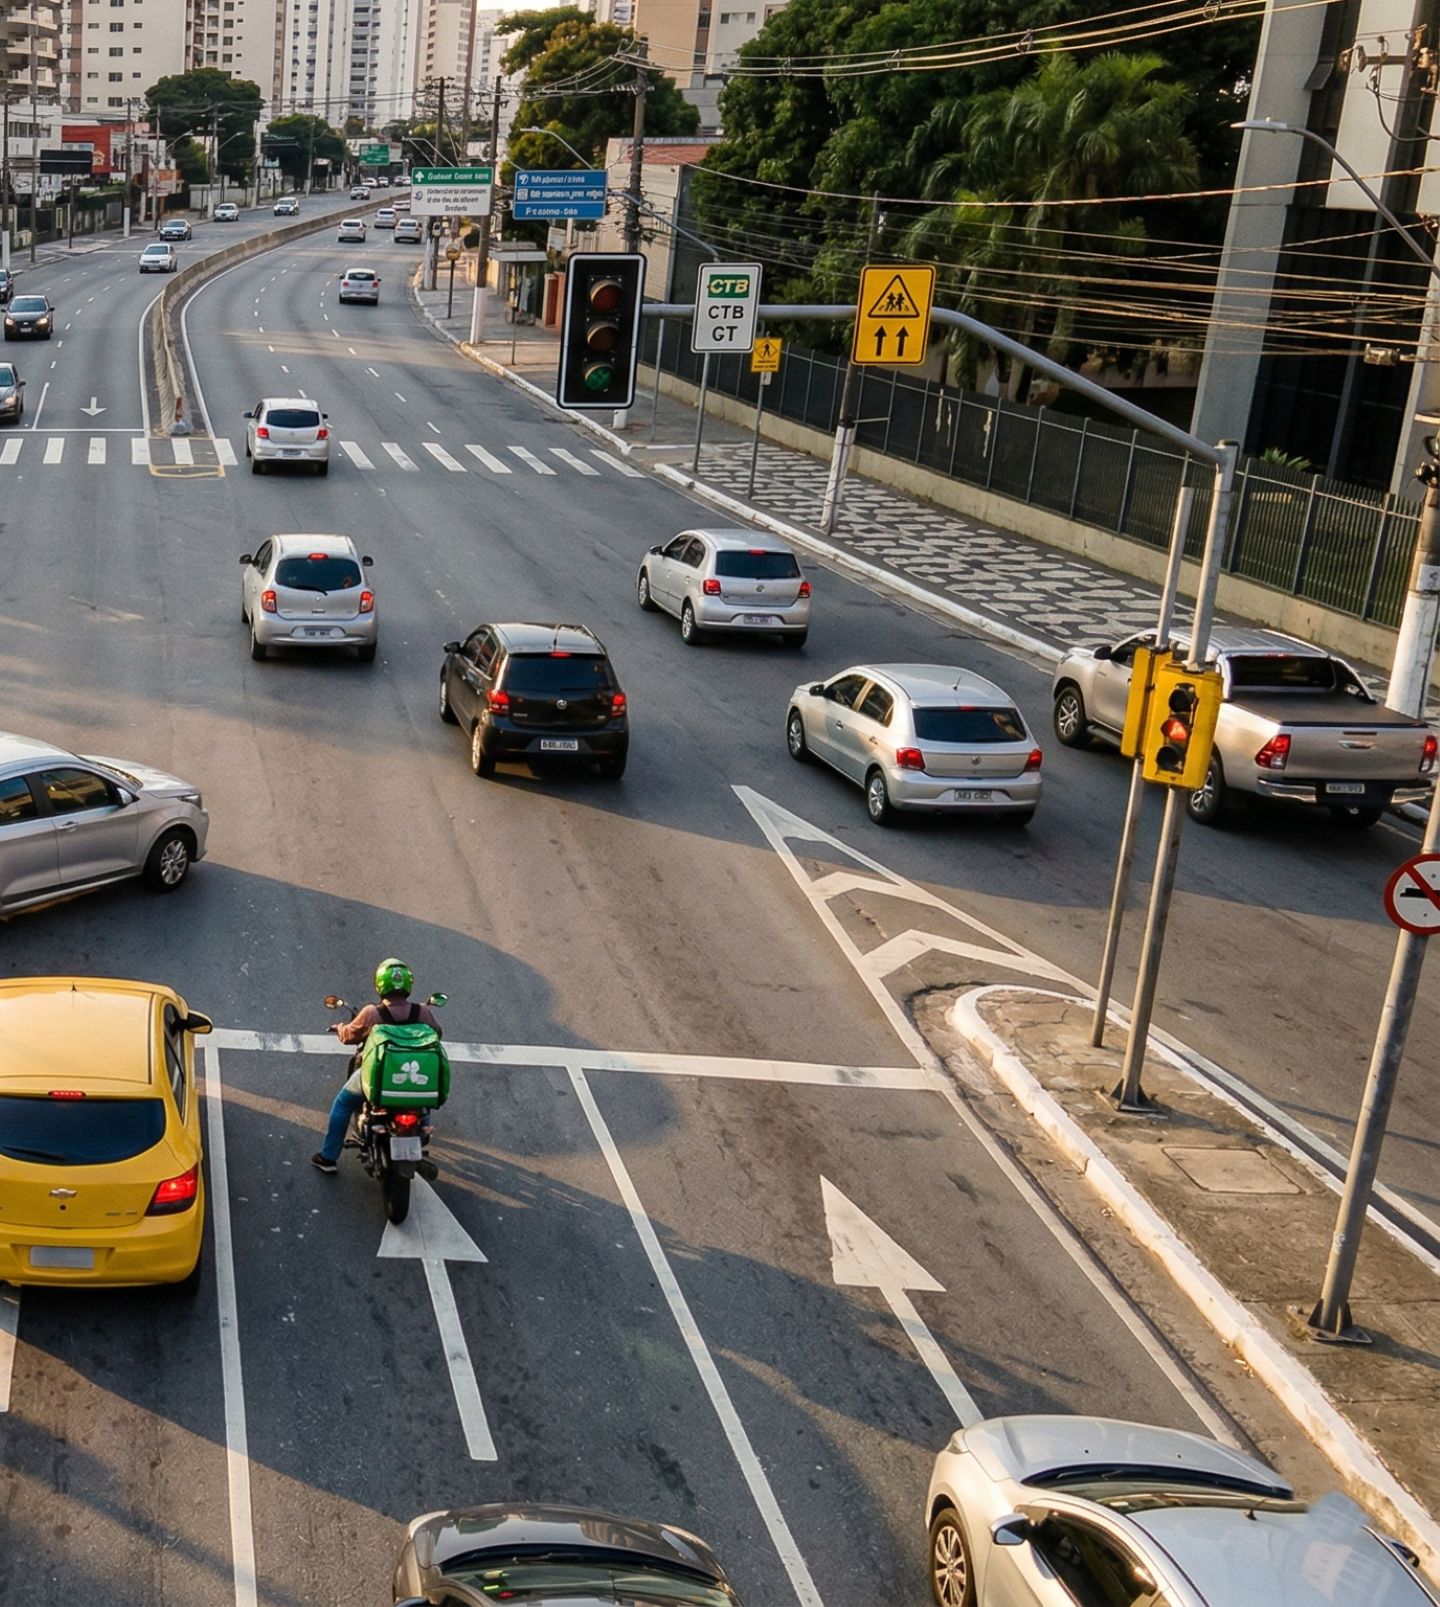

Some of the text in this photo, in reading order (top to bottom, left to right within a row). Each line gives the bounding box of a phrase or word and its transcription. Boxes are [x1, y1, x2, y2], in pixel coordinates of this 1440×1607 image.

[709, 279, 749, 294] CTB
[708, 305, 744, 319] CTB
[712, 326, 738, 342] GT
